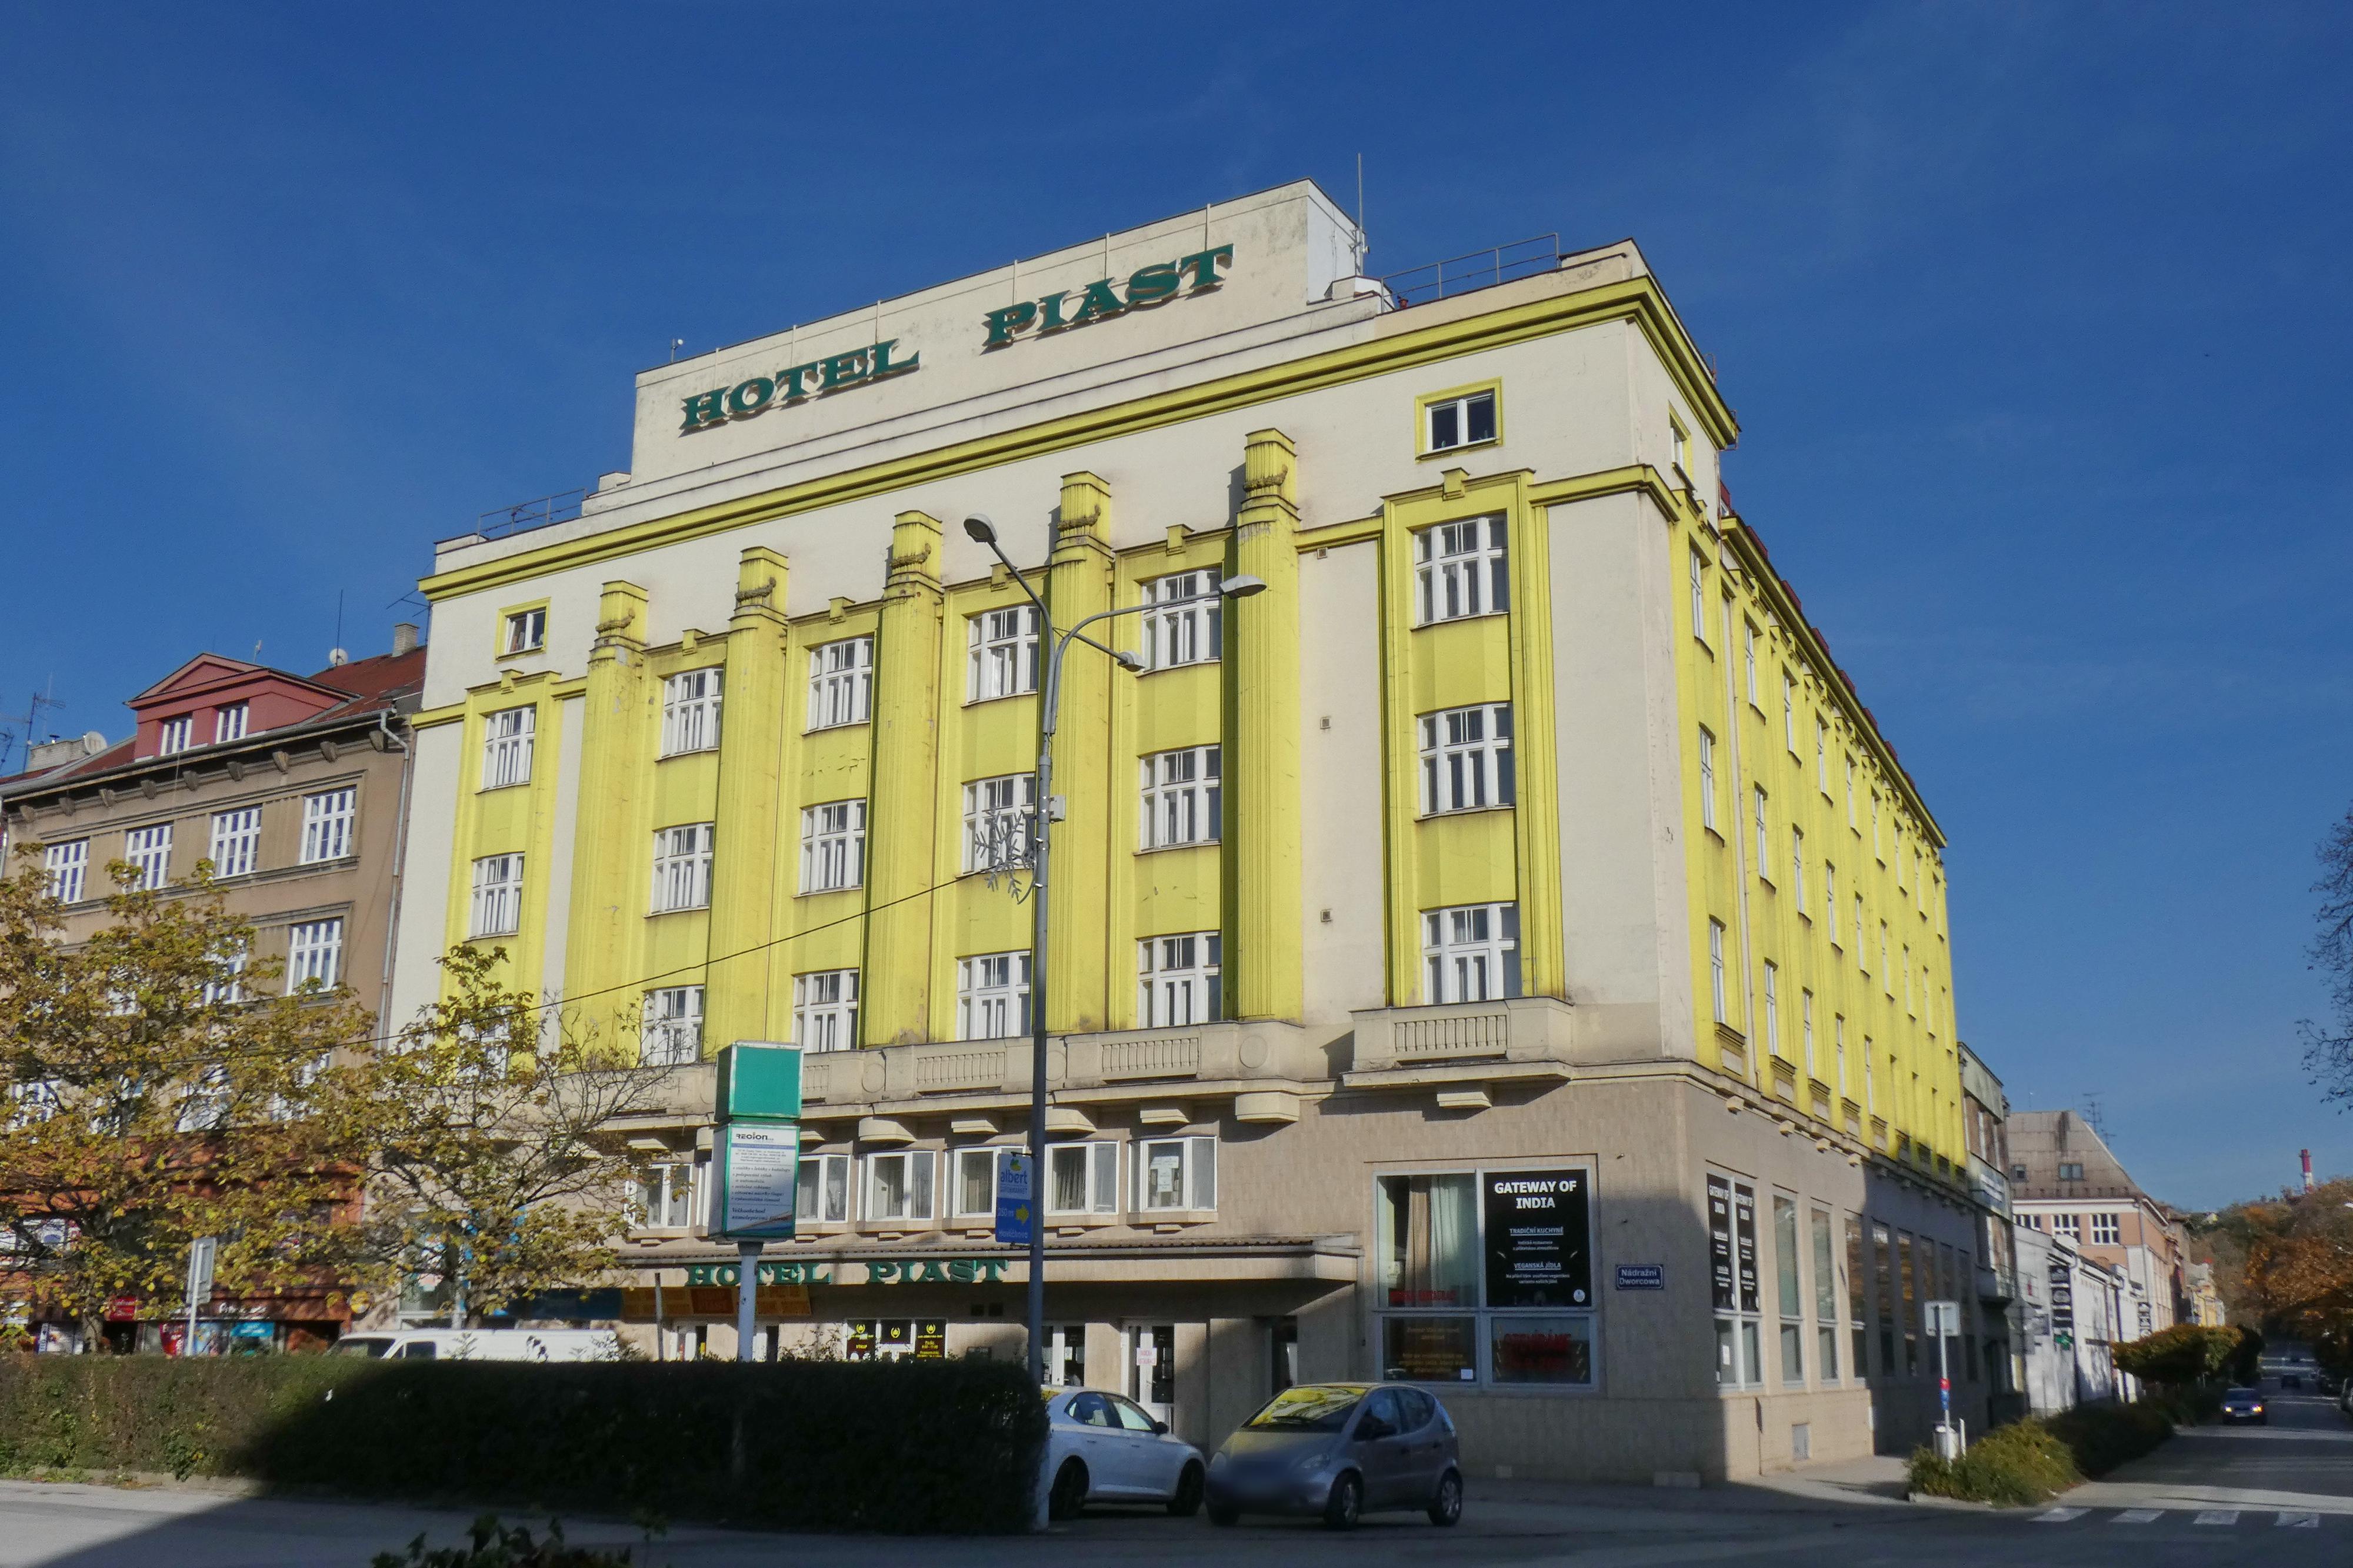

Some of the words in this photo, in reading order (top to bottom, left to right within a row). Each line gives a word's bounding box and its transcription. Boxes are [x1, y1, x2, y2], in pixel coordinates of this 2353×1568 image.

[679, 338, 920, 430] HOTEL
[982, 243, 1235, 346] PIAST
[1001, 1169, 1028, 1185] albert
[1494, 1180, 1557, 1195] GATEWAY
[1559, 1180, 1577, 1192] OF
[1515, 1197, 1556, 1209] INDIA
[686, 1261, 831, 1286] HOTEL
[865, 1259, 1010, 1283] PIAST
[1621, 1269, 1657, 1277] Nádražní
